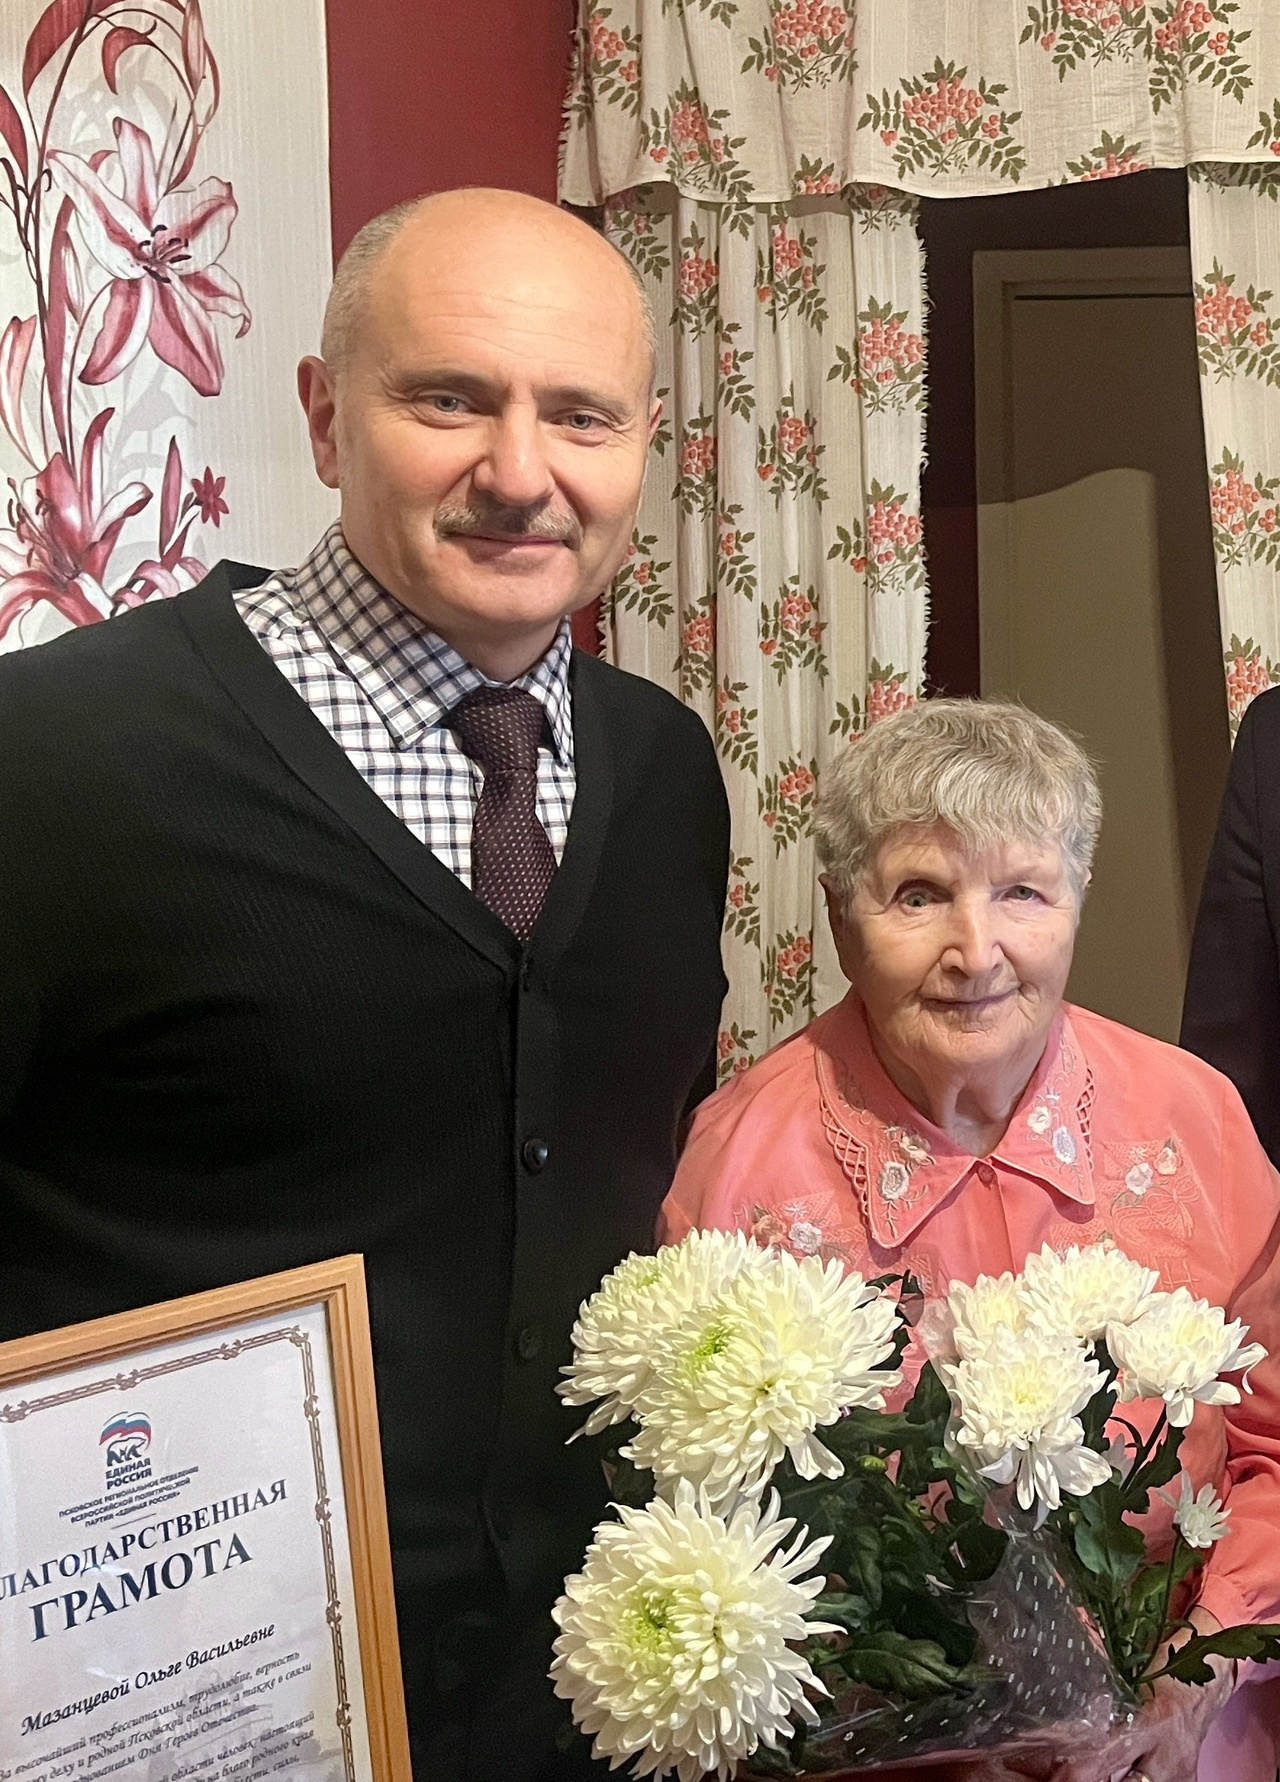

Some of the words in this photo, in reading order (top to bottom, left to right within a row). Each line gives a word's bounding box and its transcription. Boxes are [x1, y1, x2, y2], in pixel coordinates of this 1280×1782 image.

[106, 1458, 150, 1479] ЕДИНАЯ
[107, 1468, 152, 1490] РОССИЯ
[59, 1498, 102, 1518] ПСКОВСКОЕ
[105, 1479, 158, 1502] РЕГИОНАЛЬНОЕ
[71, 1496, 133, 1523] ВСЕРОССИЙСКОЙ
[0, 1479, 287, 1599] ЛАГОДАРСТВЕННАЯ
[85, 1513, 114, 1527] ПАРТИИ
[29, 1533, 253, 1642] ГРАМОТА
[21, 1678, 130, 1736] Мазанцевой
[135, 1661, 181, 1689] Ольге
[186, 1624, 275, 1669] Васильевне
[15, 1737, 86, 1774] высочайший
[255, 1652, 299, 1676] верность
[50, 1763, 74, 1779] делу
[78, 1759, 84, 1767] и
[87, 1739, 125, 1768] родной
[128, 1714, 183, 1747] Псковской
[233, 1693, 240, 1702] а
[243, 1679, 275, 1698] также
[278, 1675, 284, 1684] в
[285, 1663, 312, 1680] связи
[138, 1744, 161, 1760] Дня
[164, 1728, 198, 1749] Героев
[252, 1740, 289, 1768] родного
[292, 1730, 314, 1746] края
